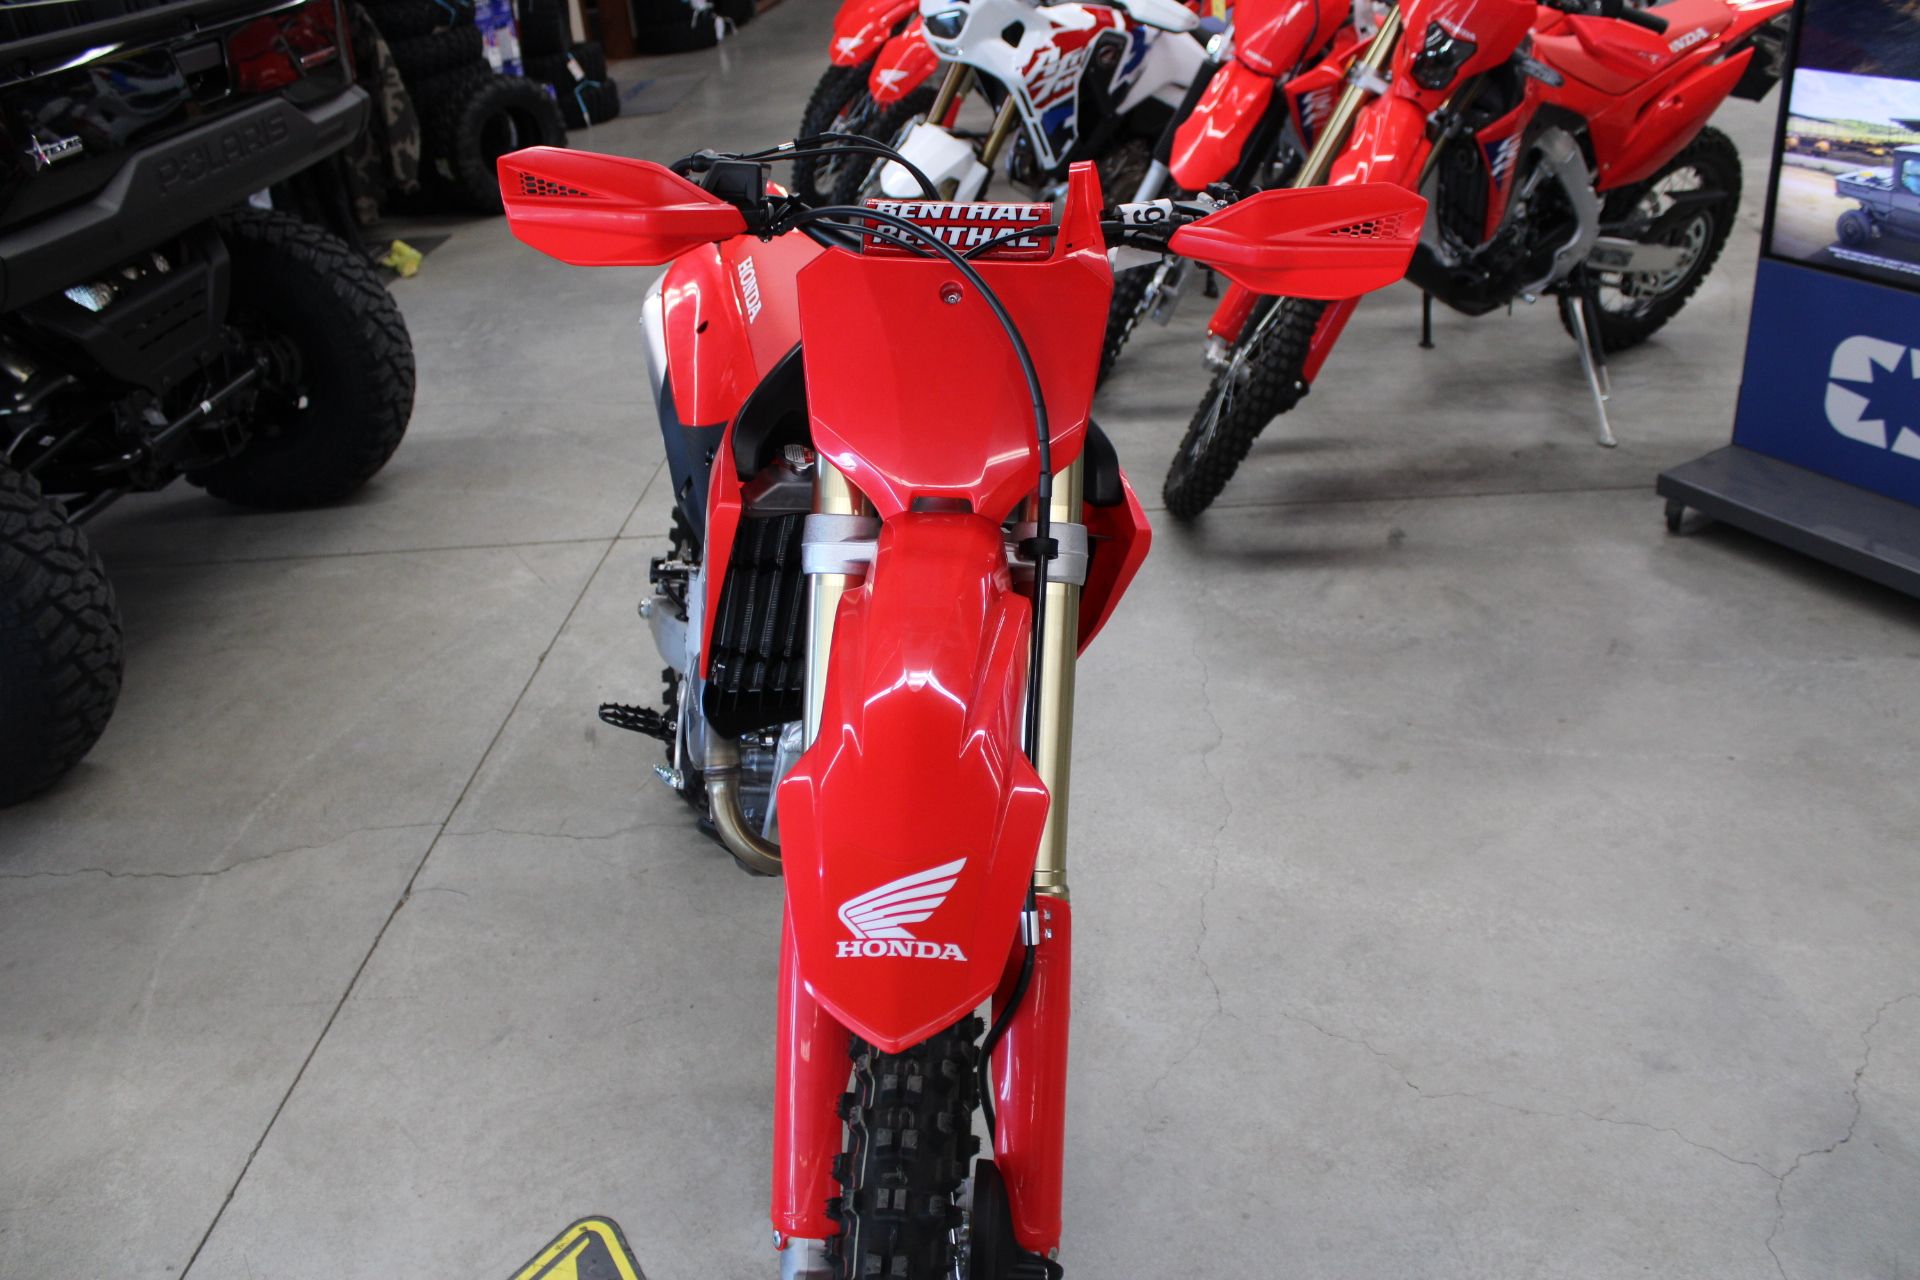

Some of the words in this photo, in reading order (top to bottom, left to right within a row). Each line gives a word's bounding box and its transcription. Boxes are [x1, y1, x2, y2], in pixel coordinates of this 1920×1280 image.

[158, 114, 289, 197] POLARIS
[876, 203, 1040, 220] RENTHAL
[737, 255, 762, 325] HONDA
[836, 940, 968, 962] HONDA
